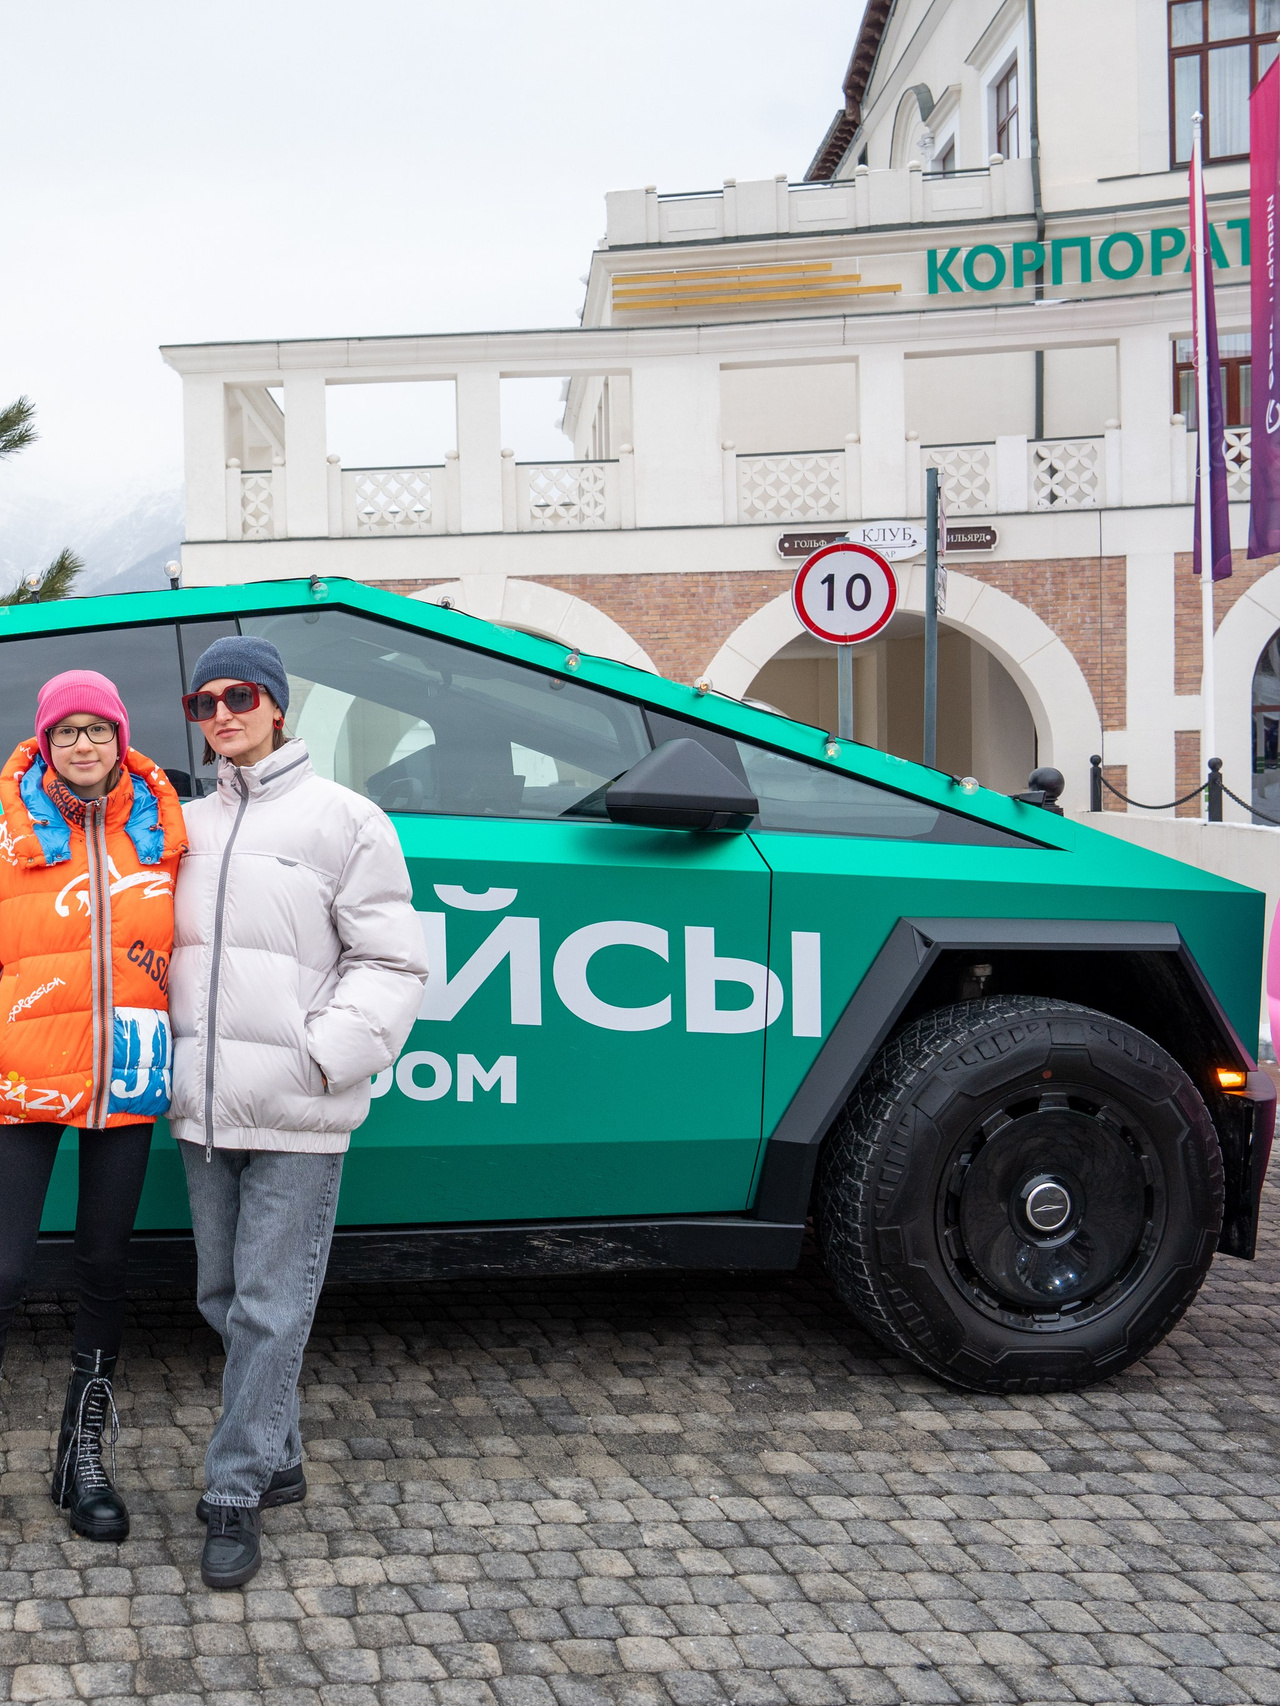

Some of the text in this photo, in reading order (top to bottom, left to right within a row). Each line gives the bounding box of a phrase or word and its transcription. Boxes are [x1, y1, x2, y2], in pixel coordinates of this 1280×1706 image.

[862, 527, 913, 542] КЛУБ
[946, 532, 987, 543] ИЛЬЯРД
[793, 539, 827, 549] ГОЛЬФ
[820, 573, 872, 612] 10
[127, 939, 169, 996] CASU
